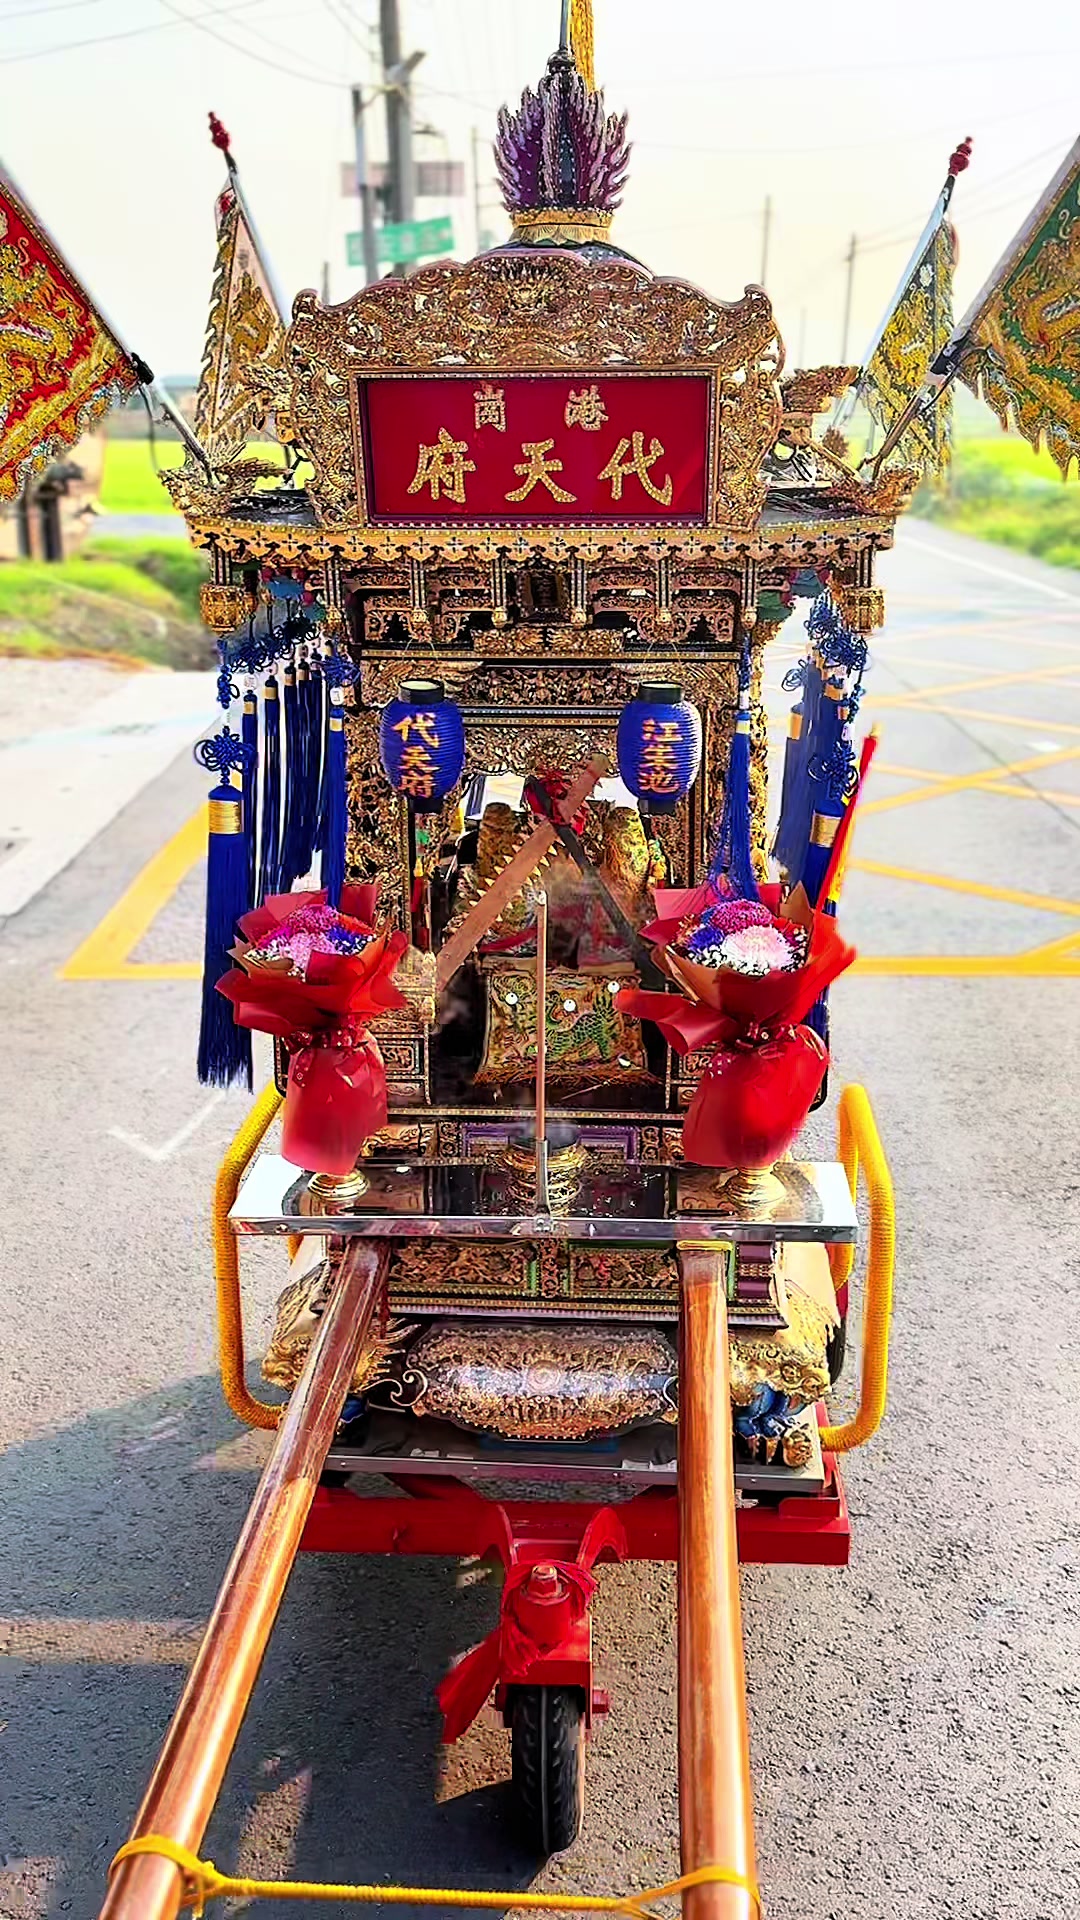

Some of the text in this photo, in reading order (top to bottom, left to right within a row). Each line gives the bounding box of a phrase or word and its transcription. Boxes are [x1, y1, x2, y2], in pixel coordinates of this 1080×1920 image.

[406, 427, 673, 506] 代天府
[391, 711, 440, 798] 代天府
